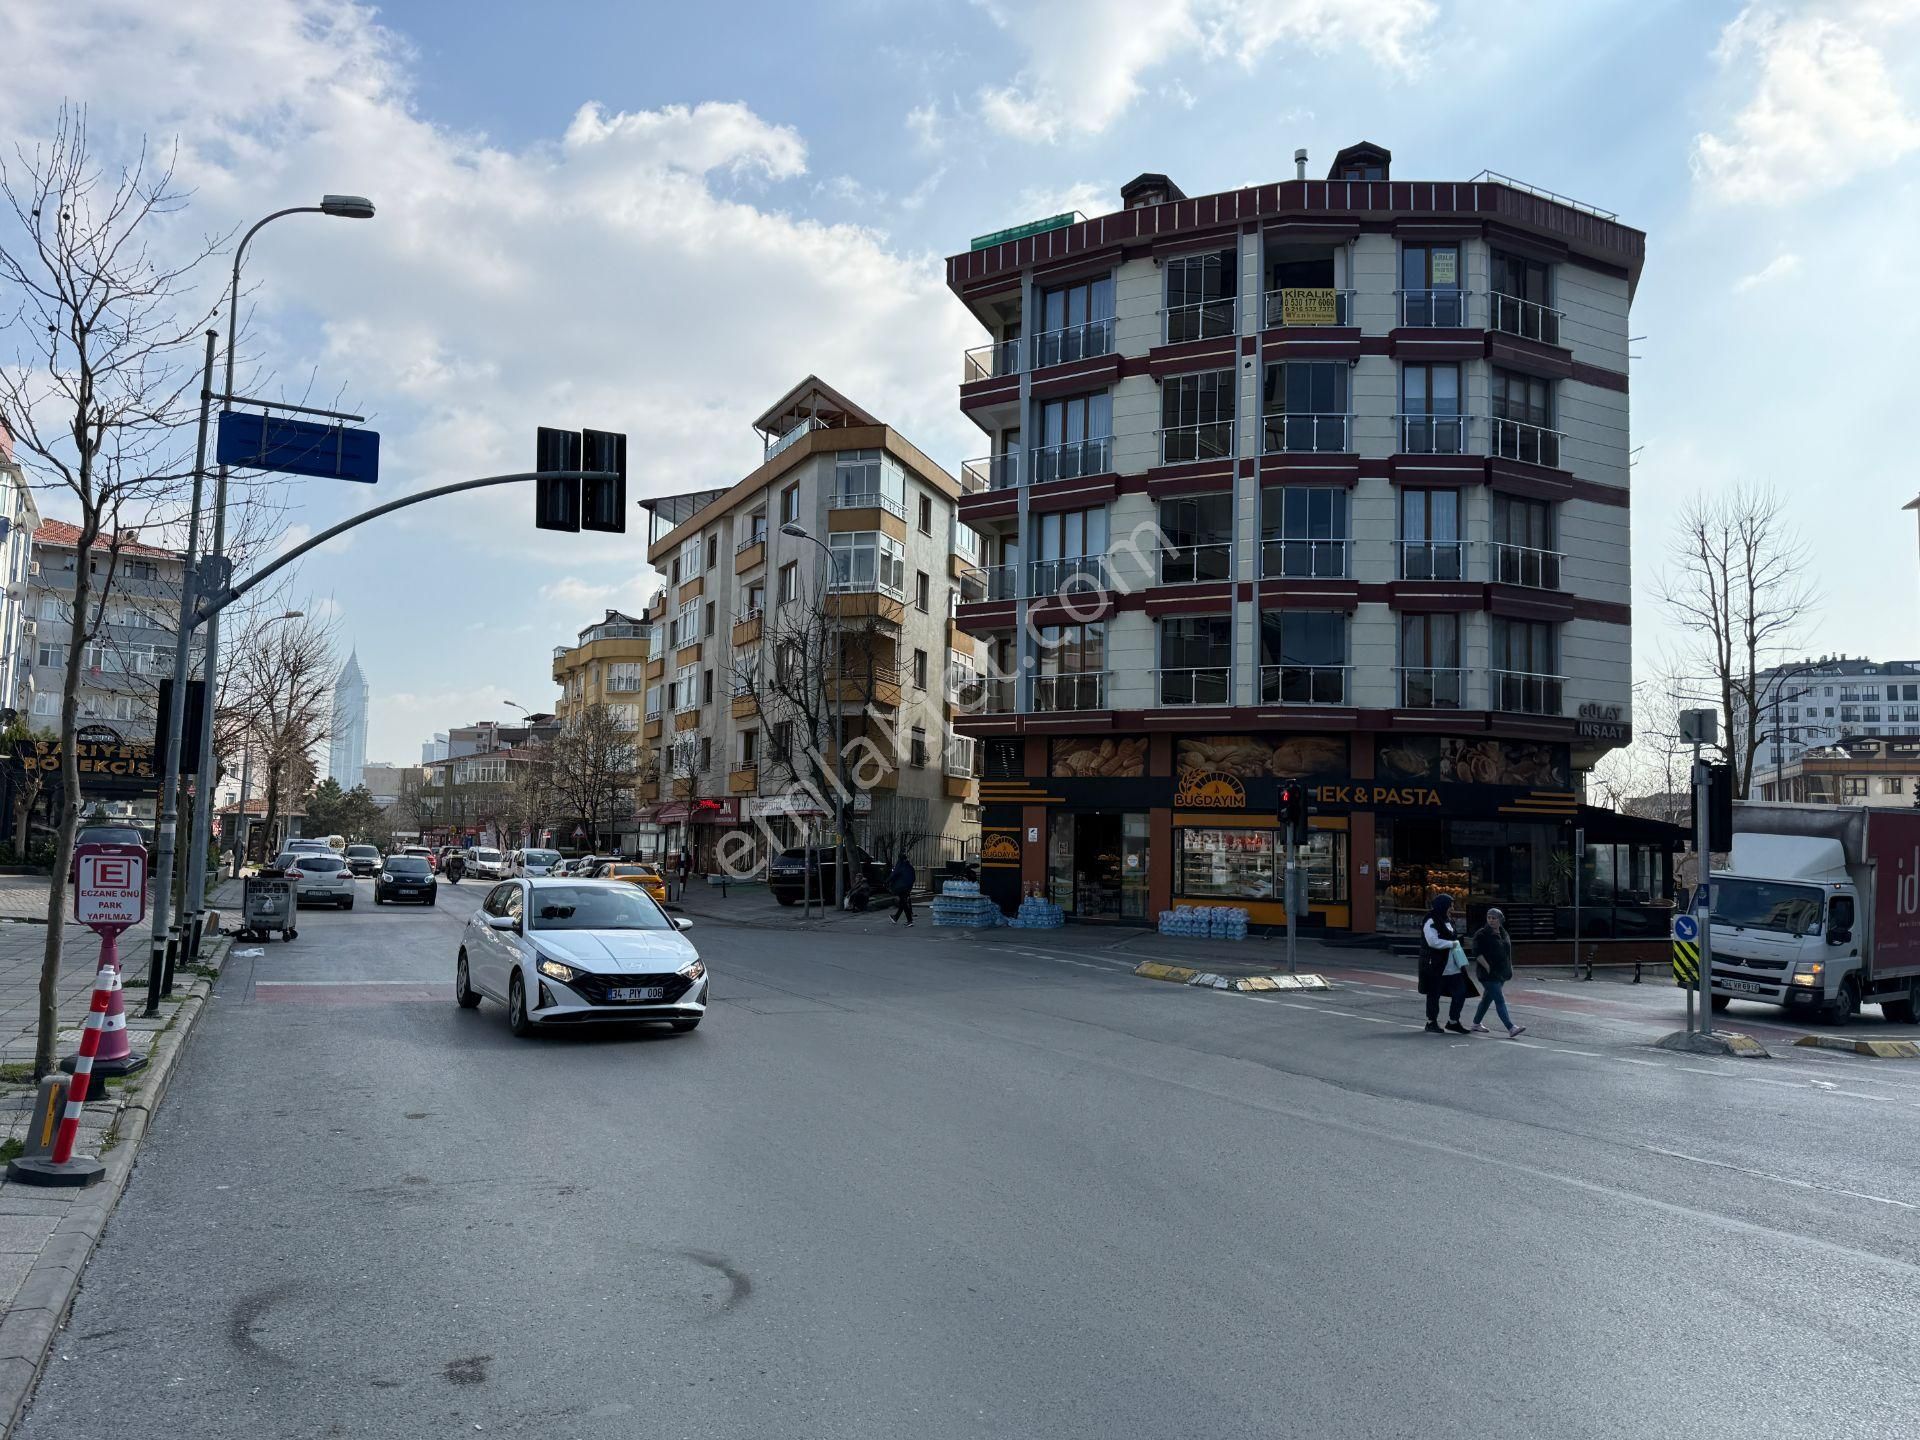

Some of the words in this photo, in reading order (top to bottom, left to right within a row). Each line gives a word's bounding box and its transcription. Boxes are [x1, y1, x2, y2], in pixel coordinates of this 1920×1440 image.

[1285, 289, 1333, 298] KİRALIK
[1290, 298, 1302, 306] 530
[1176, 792, 1244, 805] BUĞDAYIM
[1316, 786, 1351, 802] EK
[1354, 787, 1368, 803] &
[1374, 787, 1442, 806] PASTA
[101, 864, 123, 882] E
[120, 889, 139, 898] ÖNÜ
[87, 913, 133, 921] YAPILMAZ
[613, 988, 622, 998] 34
[629, 988, 642, 998] PIY
[648, 988, 663, 998] 008
